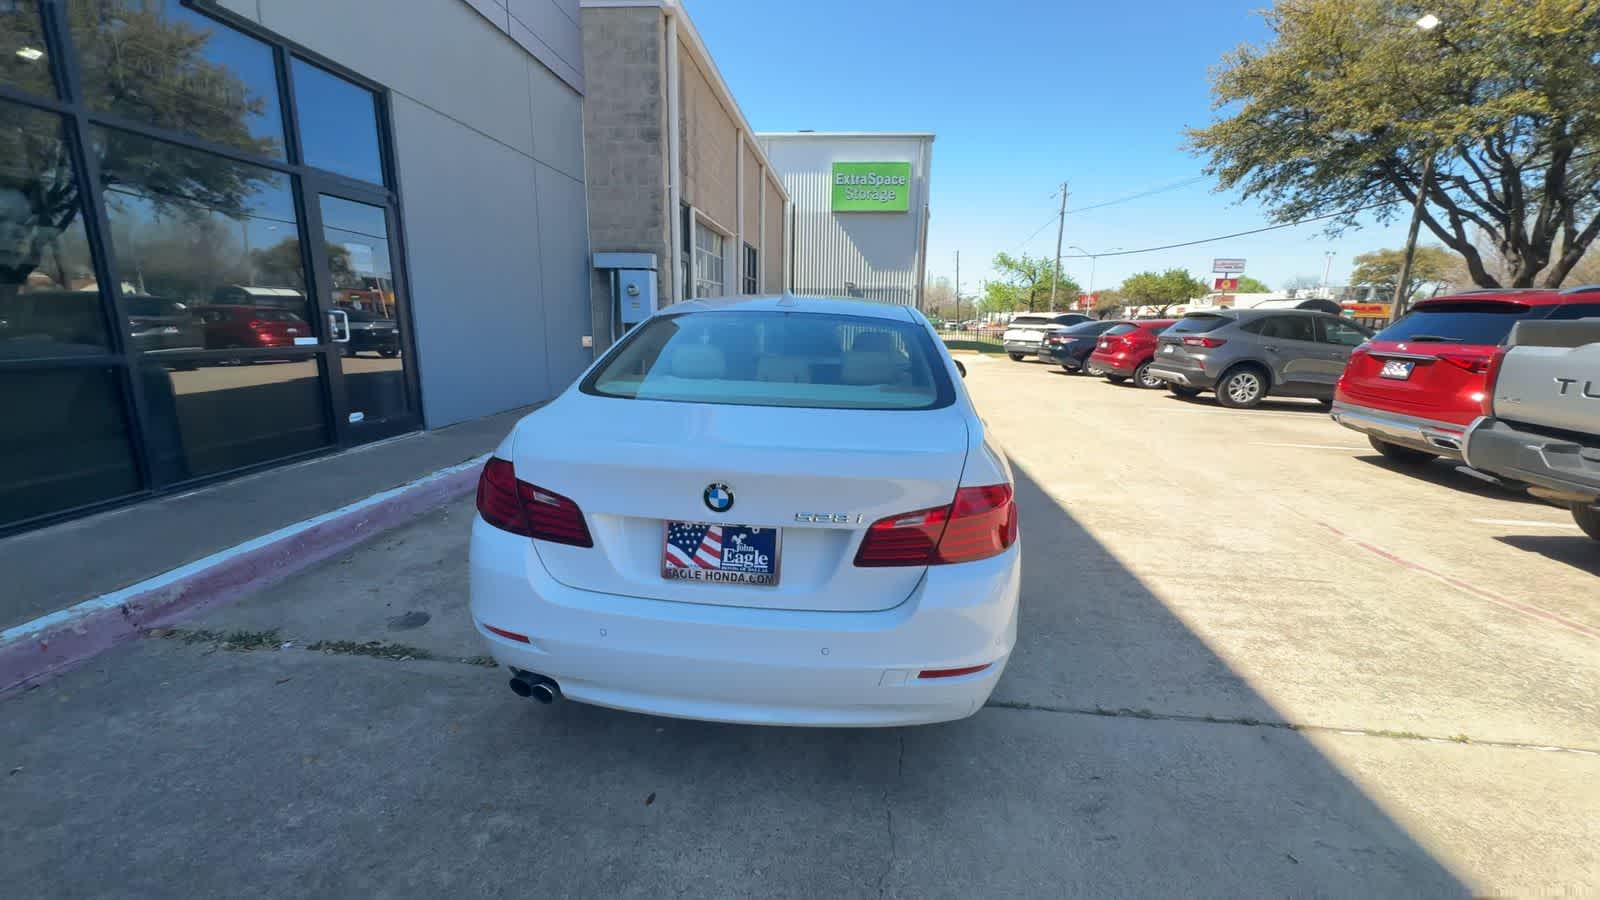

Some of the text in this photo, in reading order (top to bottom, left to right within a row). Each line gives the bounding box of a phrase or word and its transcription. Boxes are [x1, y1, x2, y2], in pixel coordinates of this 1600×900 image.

[836, 172, 905, 187] ExtraSpace
[845, 187, 896, 202] Storage
[734, 543, 754, 553] John
[723, 548, 768, 568] Eagle
[665, 568, 702, 580] EAGLE
